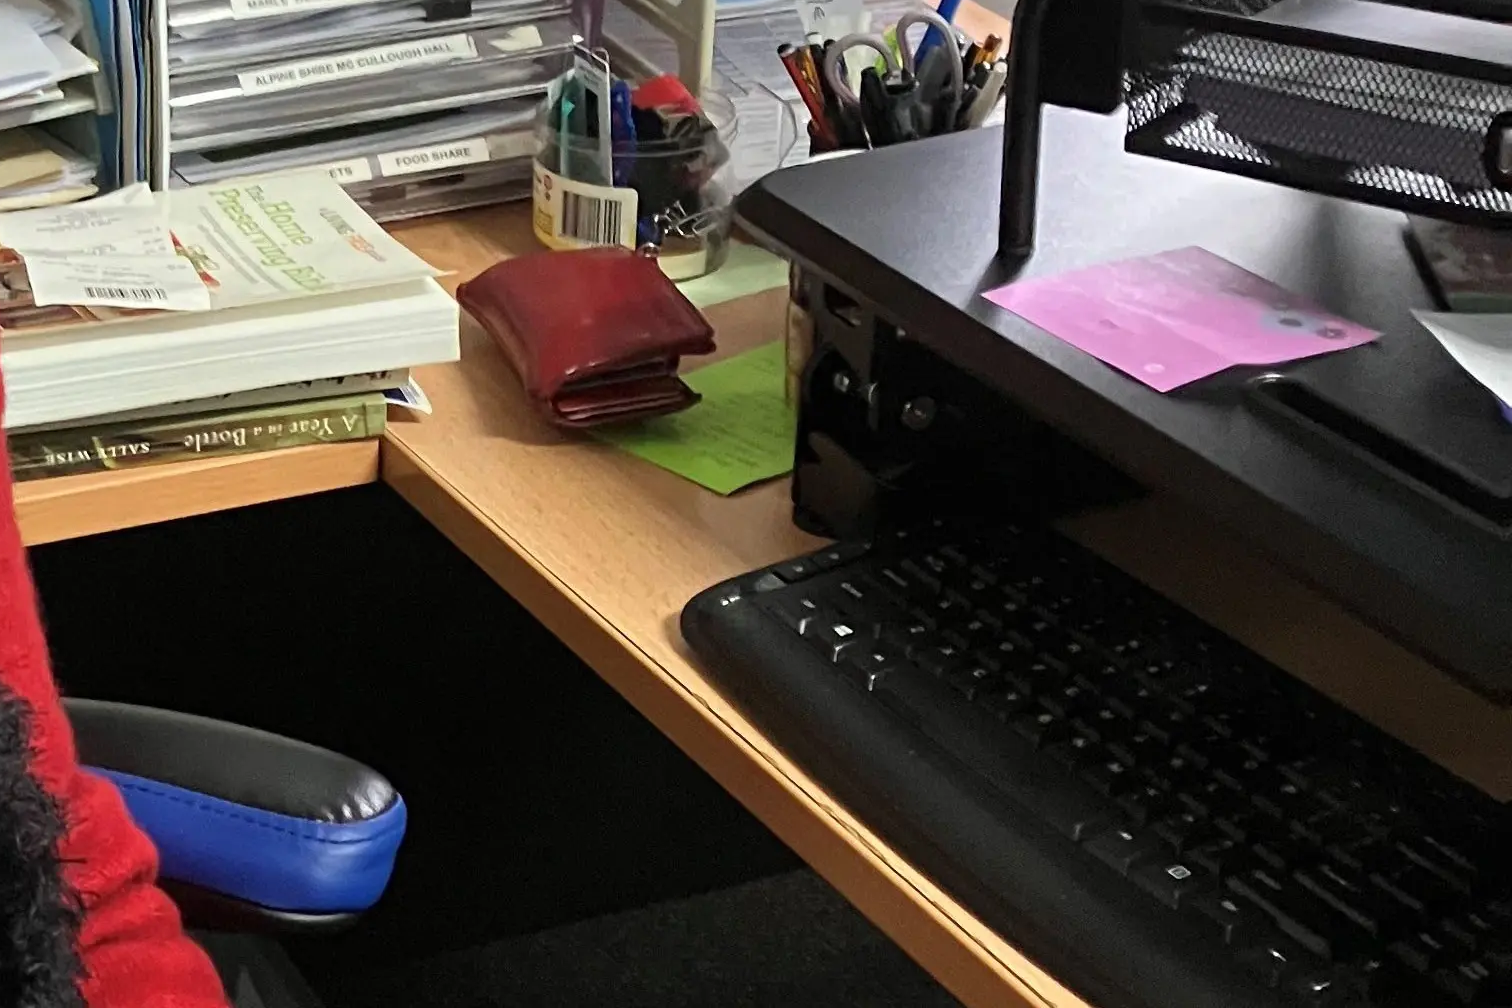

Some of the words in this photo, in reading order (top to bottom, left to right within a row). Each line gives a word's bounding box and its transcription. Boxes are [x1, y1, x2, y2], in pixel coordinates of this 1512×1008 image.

[255, 70, 296, 87] ALPINE
[298, 63, 335, 78] SHIRE
[357, 48, 422, 68] CULLOUGH
[424, 42, 454, 56] HALL
[395, 152, 430, 168] FOOD
[433, 147, 472, 163] SHARE
[208, 188, 297, 267] Preserving
[263, 201, 314, 246] Home
[253, 426, 263, 436] a
[268, 423, 283, 436] in
[288, 417, 335, 436] Year
[341, 414, 359, 432] A
[183, 427, 247, 452] Bottle
[45, 450, 92, 465] WISE
[97, 442, 151, 459] SALLY
